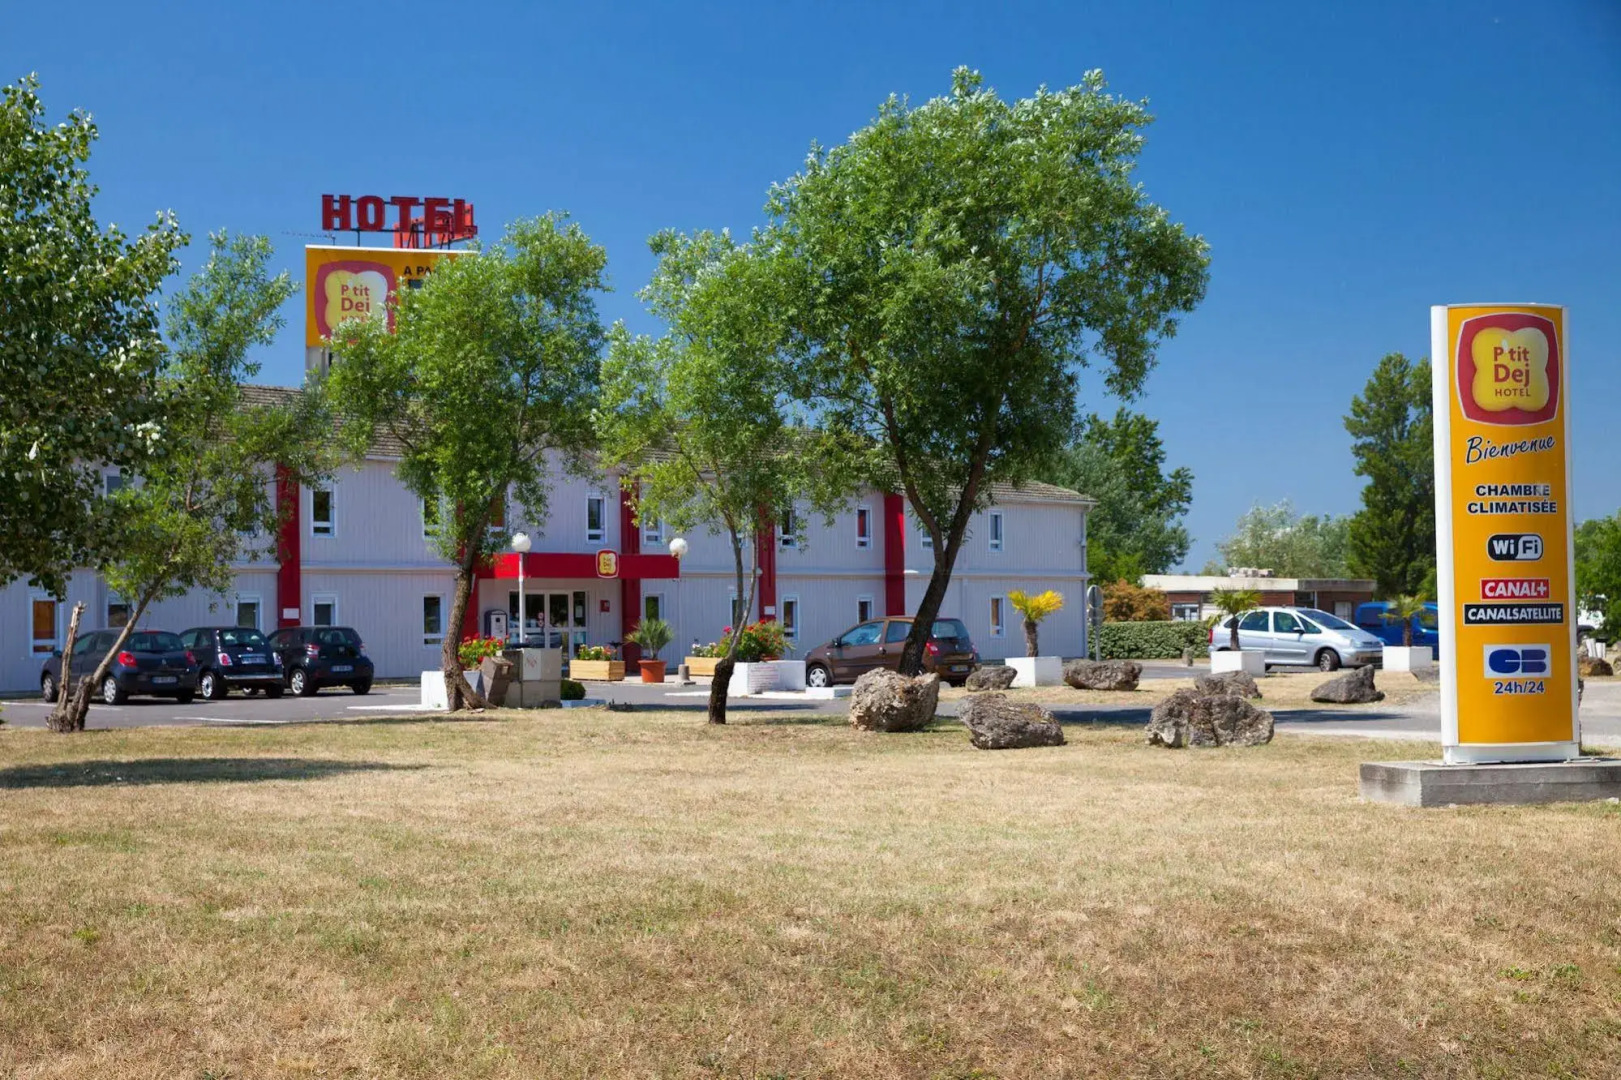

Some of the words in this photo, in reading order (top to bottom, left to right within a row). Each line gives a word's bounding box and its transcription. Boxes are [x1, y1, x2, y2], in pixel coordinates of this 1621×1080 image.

[322, 194, 477, 236] HOTEL
[404, 265, 412, 276] A
[416, 265, 432, 276] PA
[1493, 341, 1530, 362] P'tit
[1494, 363, 1530, 388] Dej
[1494, 388, 1531, 398] HOTEL
[1466, 436, 1556, 464] Bienvenue
[1475, 484, 1550, 497] CHAMBRE
[1467, 499, 1557, 514] CLIMATISÉE
[1484, 582, 1548, 597] CANAL+
[1467, 607, 1562, 620] CANALSATELLITE
[1488, 649, 1547, 673] CB
[1494, 681, 1545, 694] 24h/24
